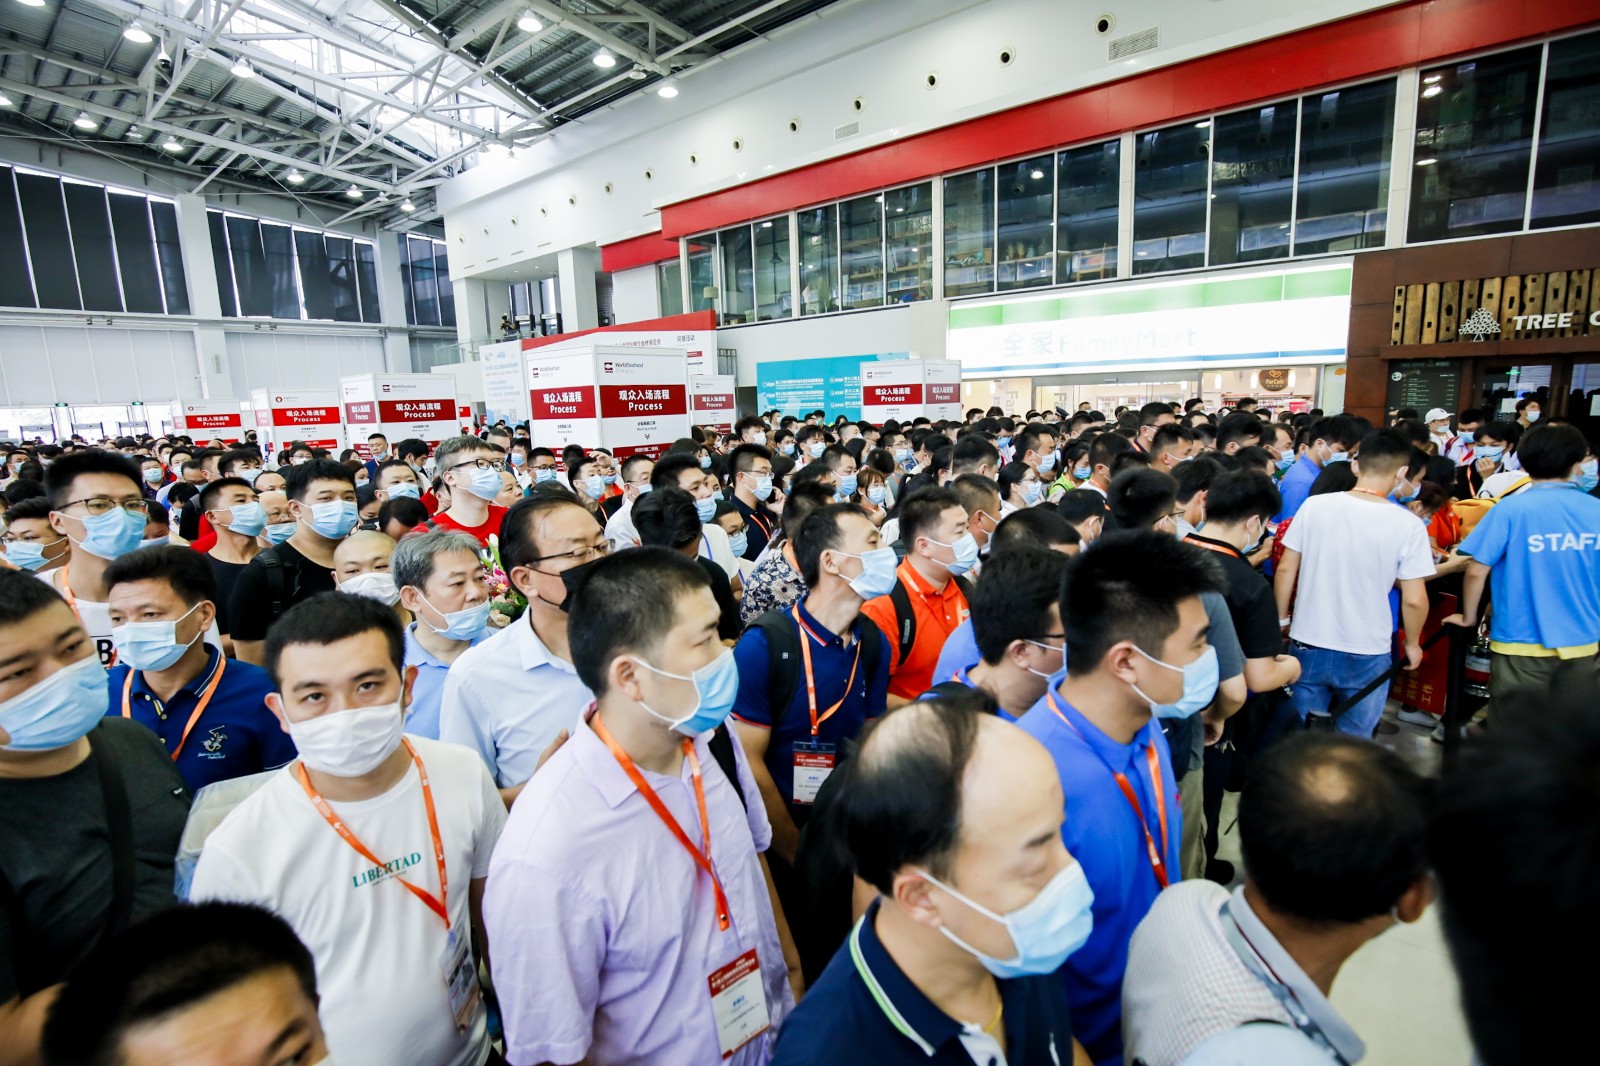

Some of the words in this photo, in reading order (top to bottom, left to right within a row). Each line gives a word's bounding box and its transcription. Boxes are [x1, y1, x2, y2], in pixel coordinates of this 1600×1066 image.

[1513, 312, 1573, 330] TREE
[1003, 331, 1053, 357] 全家
[1059, 326, 1197, 355] FamilyMart
[543, 391, 582, 404] 观众入场流程
[619, 390, 670, 401] 观众入场流程
[395, 403, 441, 411] 观众入场流程
[550, 405, 577, 414] Process
[628, 402, 663, 412] Process
[353, 852, 422, 888] LIBERTAD
